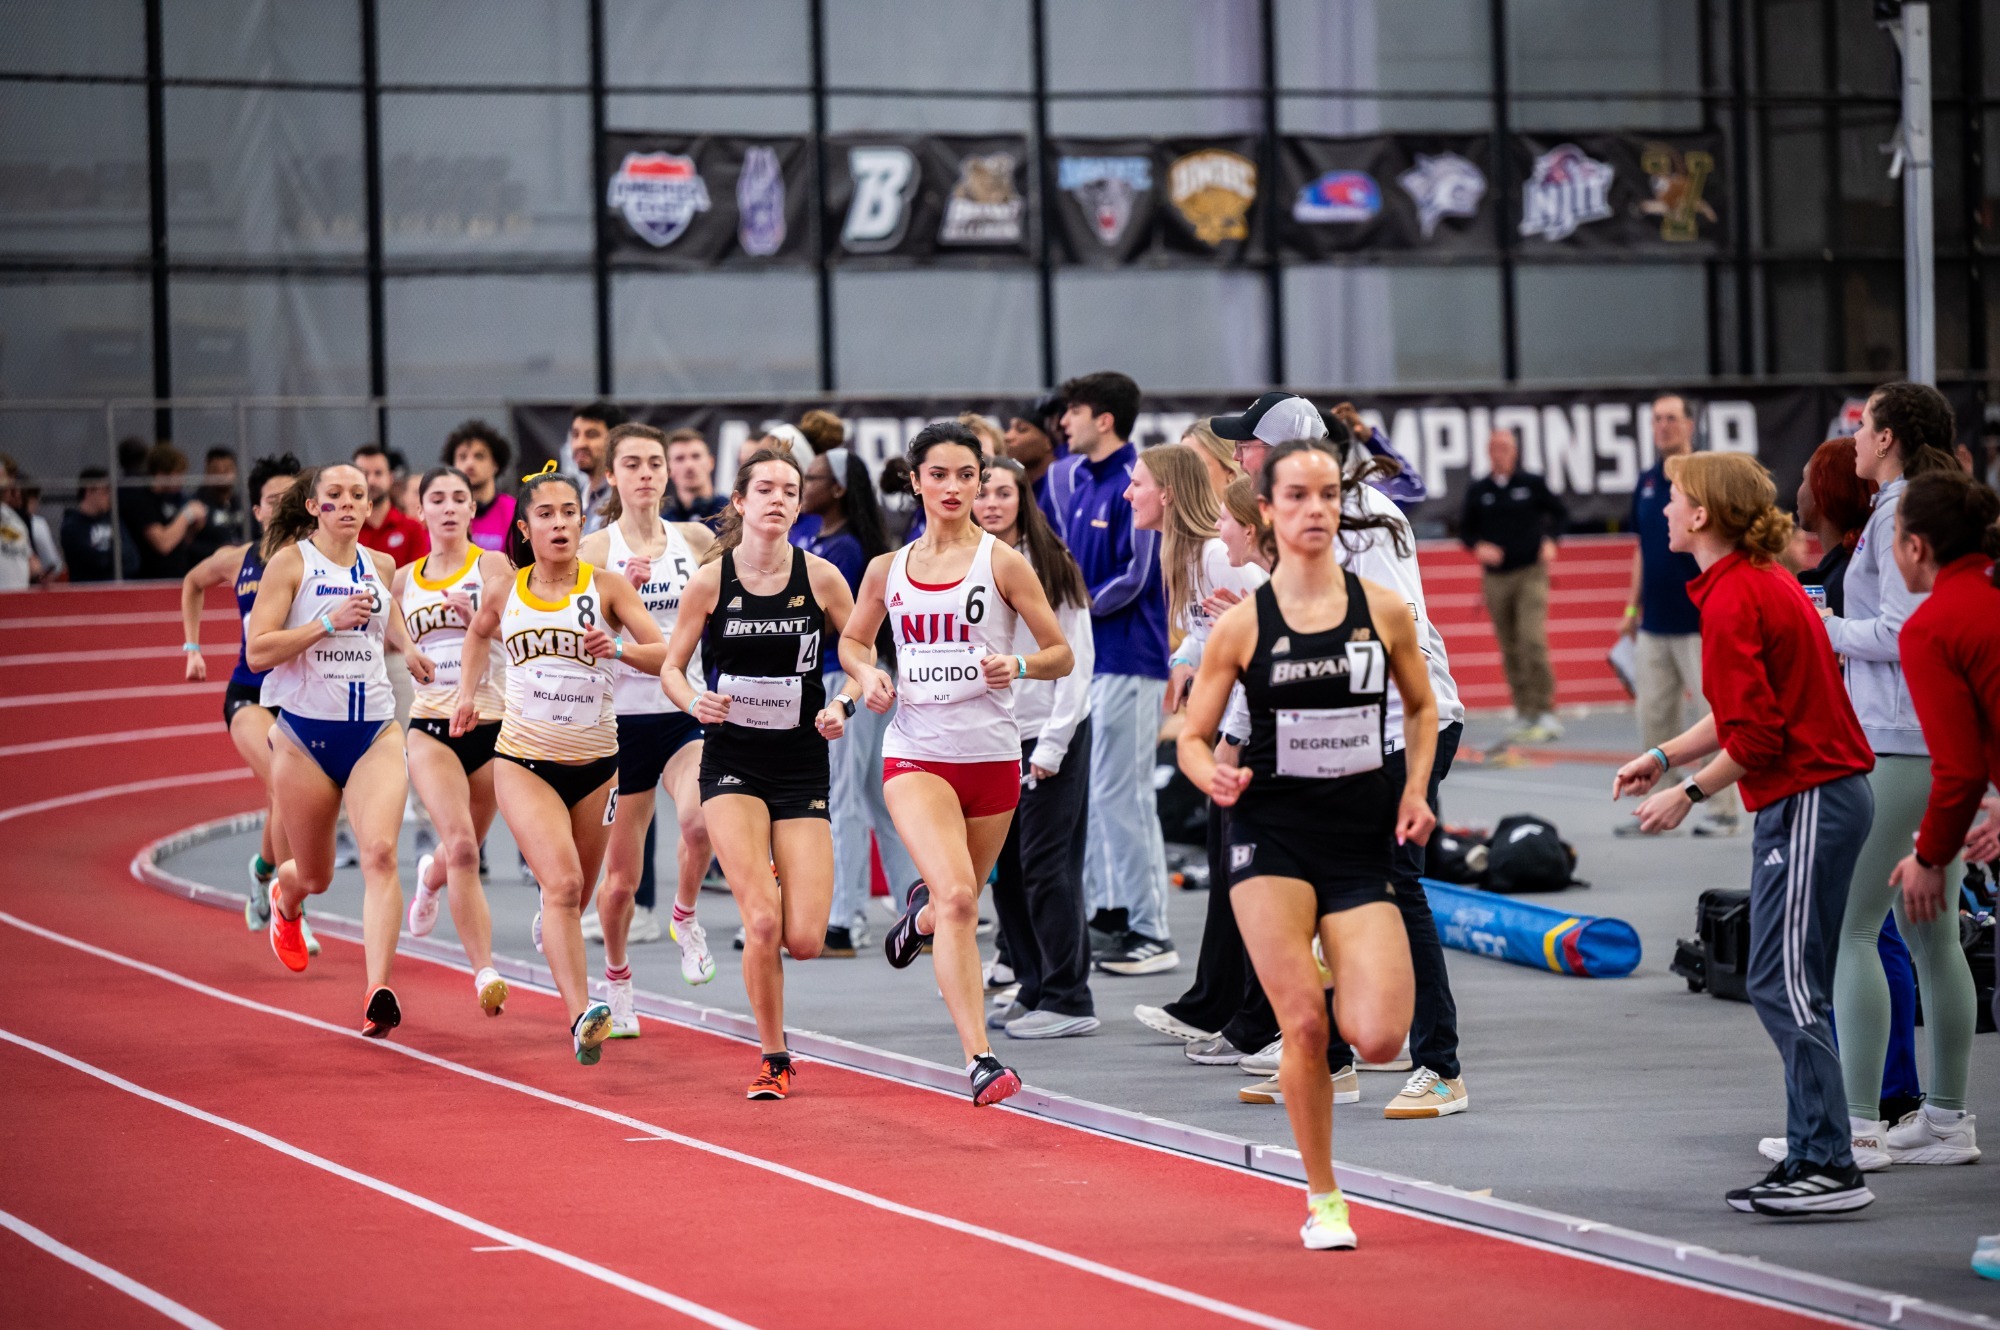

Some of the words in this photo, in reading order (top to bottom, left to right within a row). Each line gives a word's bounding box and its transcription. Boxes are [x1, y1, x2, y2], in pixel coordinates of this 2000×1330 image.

[842, 148, 916, 247] B
[674, 557, 690, 590] 5
[641, 582, 670, 594] NEW
[470, 592, 478, 612] 1
[965, 585, 986, 624] 6
[577, 595, 595, 629] 8
[725, 619, 805, 635] BRYANT
[315, 650, 372, 662] THOMAS
[801, 635, 817, 668] 4
[909, 666, 978, 682] LUCIDO
[1272, 658, 1350, 684] BRYAN
[1354, 647, 1374, 690] 7
[533, 690, 595, 703] MCLAUGHLIN
[552, 714, 573, 722] UMBC
[746, 717, 769, 726] Bryant
[1289, 735, 1370, 750] DEGRENIER
[1317, 766, 1346, 775] Bryant
